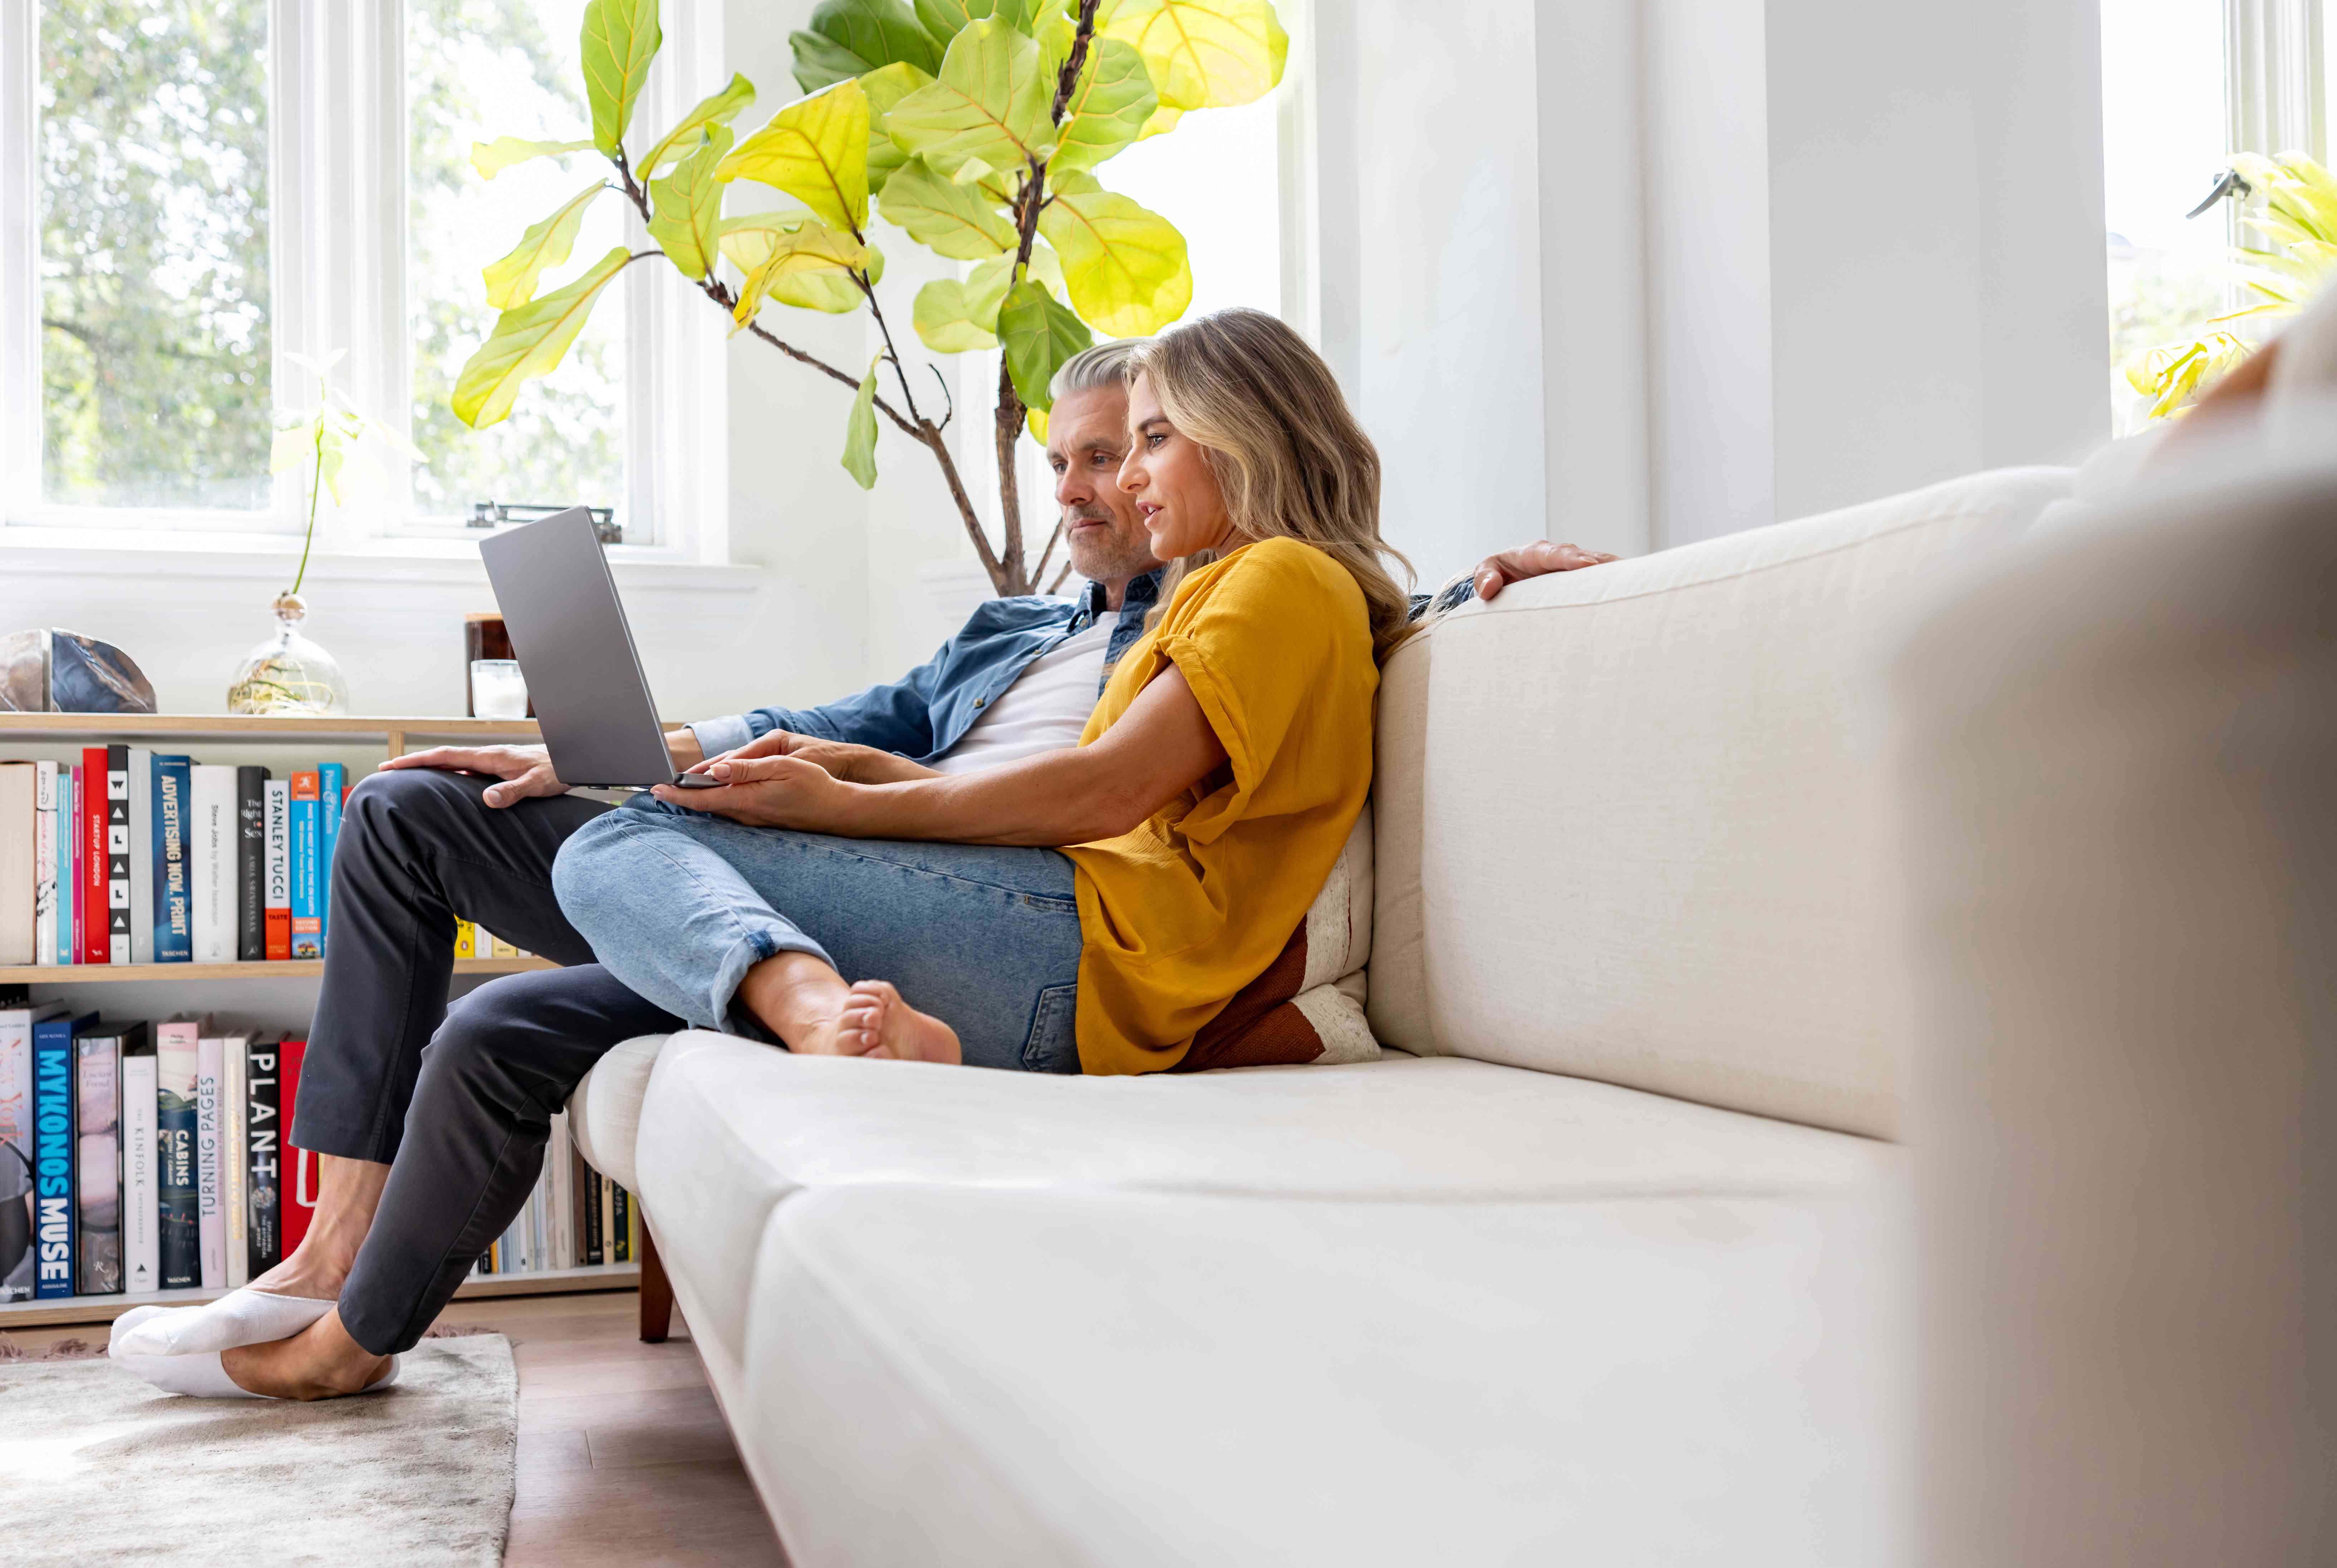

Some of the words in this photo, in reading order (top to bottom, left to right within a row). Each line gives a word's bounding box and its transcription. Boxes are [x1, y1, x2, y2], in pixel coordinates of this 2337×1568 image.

[161, 775, 182, 861] ADVERTISING
[210, 804, 219, 826] Steve
[241, 809, 262, 820] Right
[246, 799, 262, 808] The
[272, 790, 284, 850] STANLEY
[93, 814, 101, 849] STARTUP
[210, 829, 219, 848] Jobs
[245, 828, 263, 838] Sex
[93, 851, 101, 886] LONDON
[210, 850, 219, 860] by
[167, 862, 184, 895] NOW.
[272, 856, 284, 899] TUCCI
[169, 897, 186, 936] PRINT
[39, 1050, 69, 1197] MYKONOS
[200, 1077, 214, 1131] PAGES
[249, 1053, 277, 1179] PLANT
[134, 1127, 145, 1187] KINFOLK
[176, 1129, 190, 1186] CABINS
[200, 1138, 215, 1217] TURNING
[40, 1198, 69, 1280] MUSE
